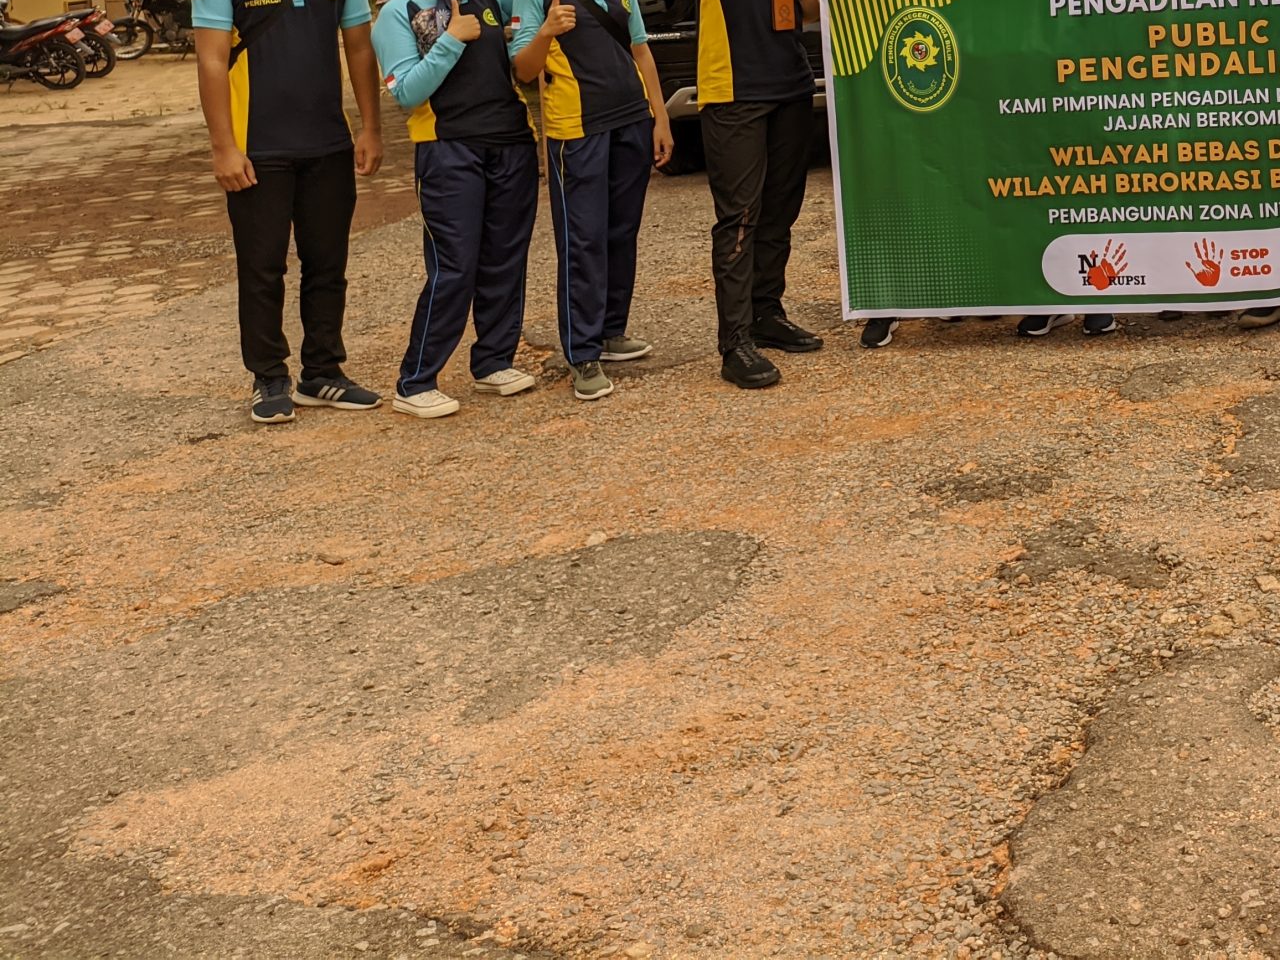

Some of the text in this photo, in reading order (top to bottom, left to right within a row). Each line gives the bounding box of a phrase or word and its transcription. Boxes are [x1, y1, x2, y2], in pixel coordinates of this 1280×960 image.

[1148, 19, 1269, 48] PUBLIC
[998, 98, 1047, 114] KAMI
[1052, 93, 1145, 113] PIMPINAN
[1150, 88, 1270, 108] PENGADILAN
[1103, 111, 1191, 132] JAJARAN
[1050, 142, 1169, 167] WILAYAH
[1177, 140, 1261, 162] BEBAS
[988, 174, 1107, 198] WILAYAH
[1115, 169, 1262, 193] BIROKRASI
[1048, 206, 1194, 224] PEMBANGUNAN
[1198, 203, 1254, 221] ZONA
[1230, 248, 1270, 261] STOP
[1082, 274, 1147, 286] KRUPSI
[1230, 263, 1272, 277] CALO
